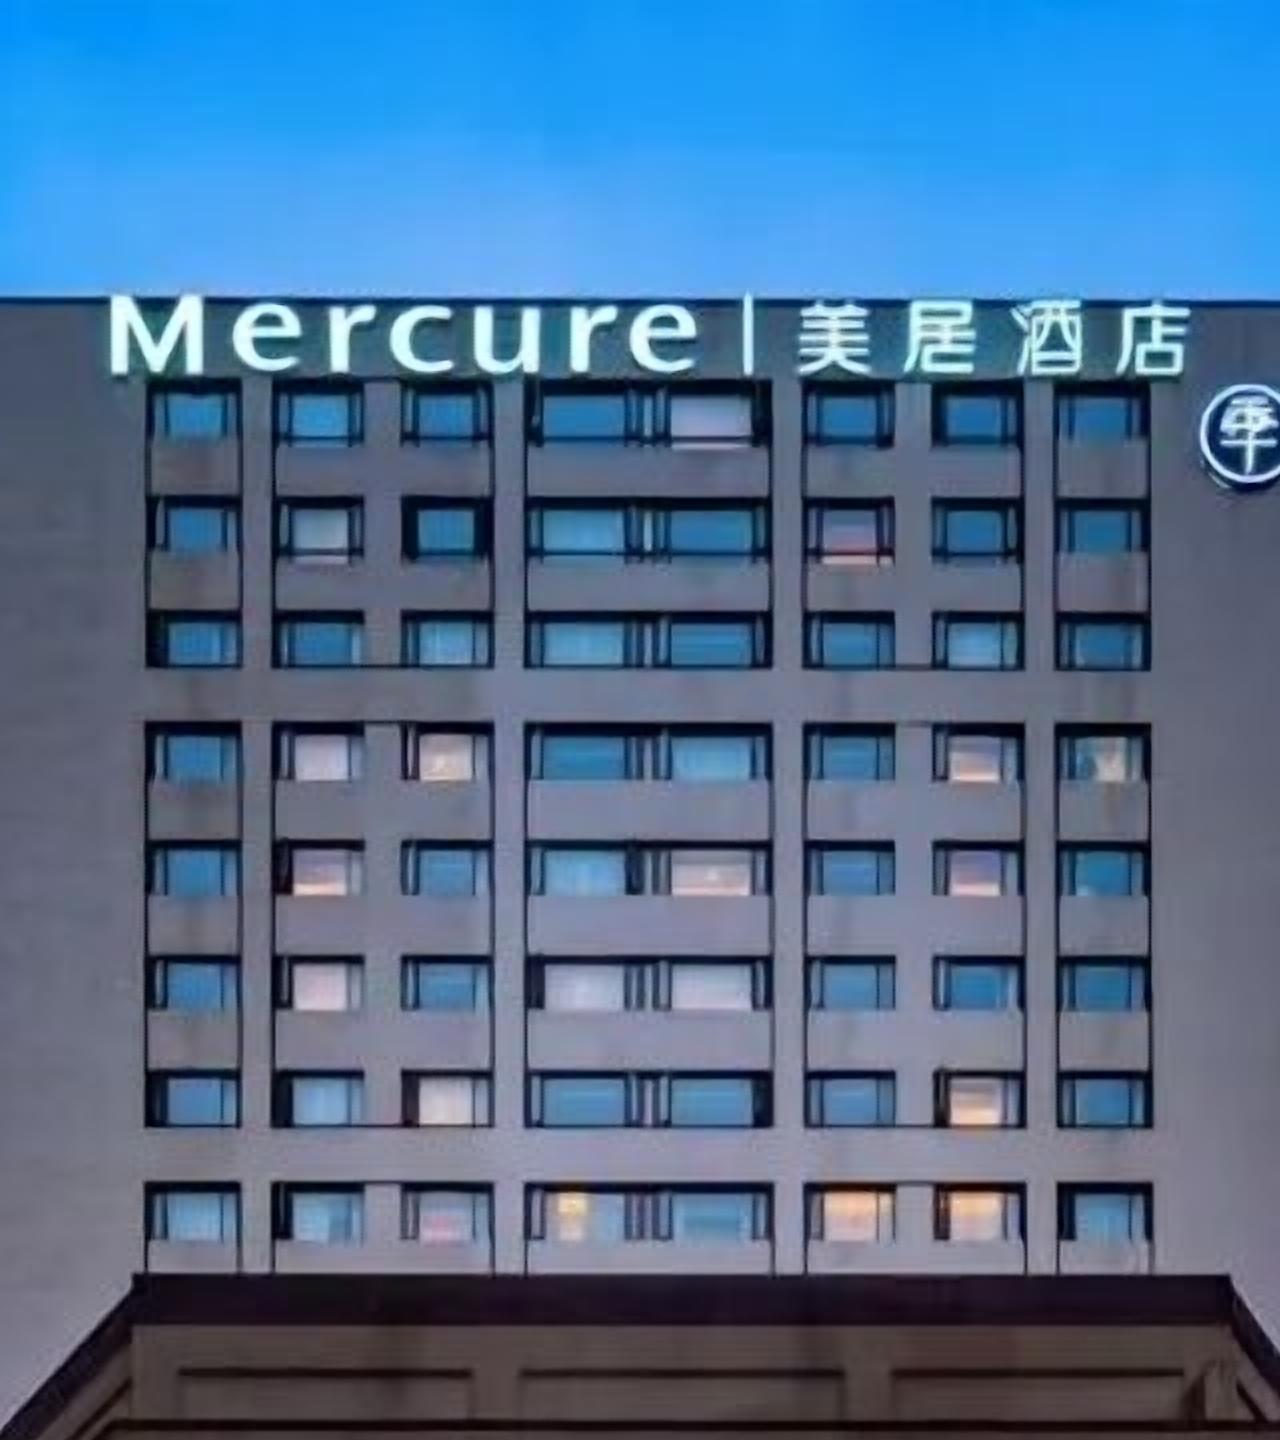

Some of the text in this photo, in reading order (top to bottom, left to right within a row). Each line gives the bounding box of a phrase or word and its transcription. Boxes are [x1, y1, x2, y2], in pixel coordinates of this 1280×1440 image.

[110, 294, 1191, 376] Mercure 美居酒店
